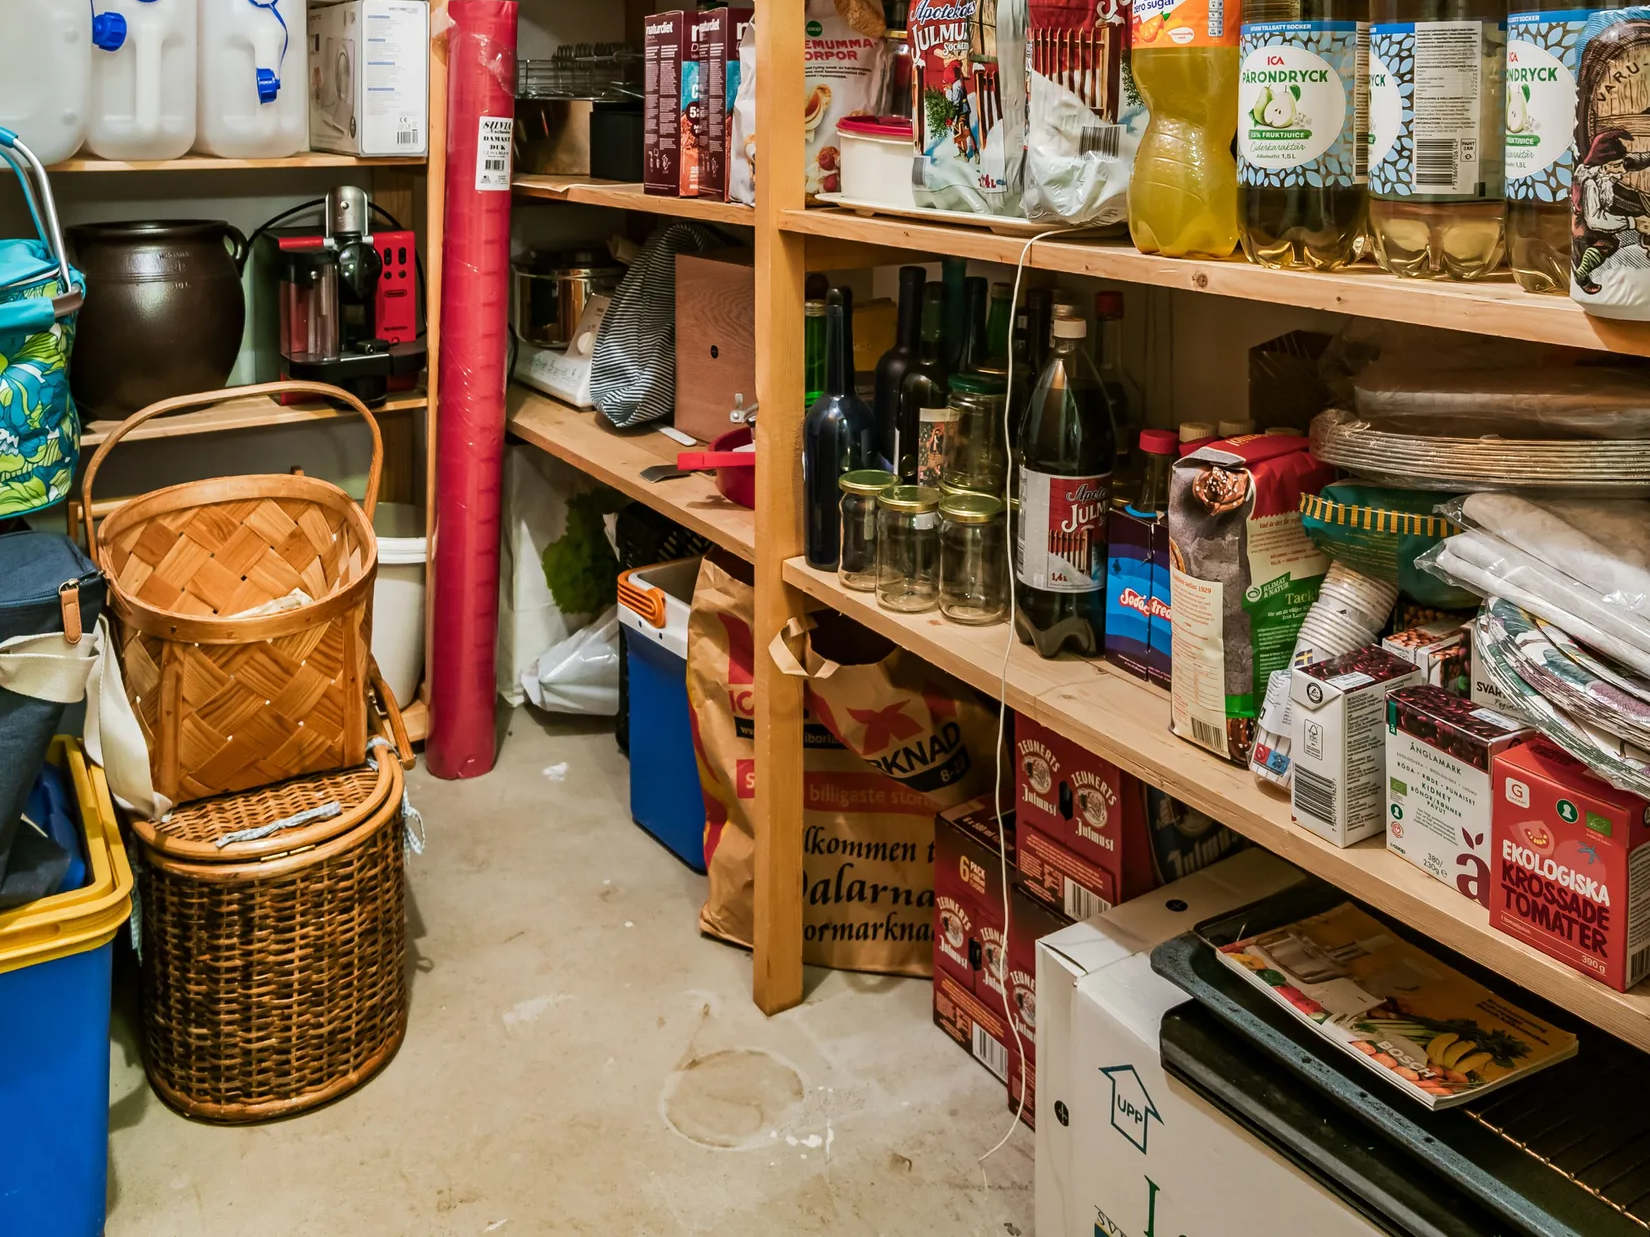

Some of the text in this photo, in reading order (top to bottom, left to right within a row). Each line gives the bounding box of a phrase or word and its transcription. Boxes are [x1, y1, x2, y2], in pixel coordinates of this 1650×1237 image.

[645, 21, 674, 35] naturdiet
[1267, 56, 1285, 66] ICA
[1242, 68, 1329, 84] PÄRONDRYCK
[1262, 131, 1305, 139] FRUKTJUICE
[1198, 585, 1212, 594] 1929
[1263, 576, 1287, 593] KLIMAT
[1268, 582, 1290, 598] NATUR
[1018, 738, 1061, 773] ZEUNERTS
[1409, 741, 1462, 776] ÄNGLAMARK
[809, 782, 886, 808] billigaste
[1071, 769, 1118, 807] ZEUNERTS
[1396, 760, 1416, 776] RÖDA
[1445, 784, 1476, 808] PUNAISET
[1421, 781, 1453, 804] KIDNEY
[1511, 783, 1524, 799] G
[1021, 783, 1058, 818] Julmust
[1426, 799, 1447, 816] PAVUT
[1075, 816, 1115, 852] Julmust
[959, 855, 970, 883] 6
[969, 860, 987, 879] PACK
[1422, 858, 1440, 877] 230g
[1502, 839, 1610, 907] EKOLOGISKA
[1502, 859, 1610, 932] KROSSADE
[936, 896, 973, 931] ZEUNERTS
[1501, 884, 1609, 959] TOMATER
[939, 934, 969, 970] Julmust
[1581, 954, 1606, 975] 390 g
[1377, 1039, 1437, 1080] BOSCH
[1116, 1093, 1144, 1124] UPP
